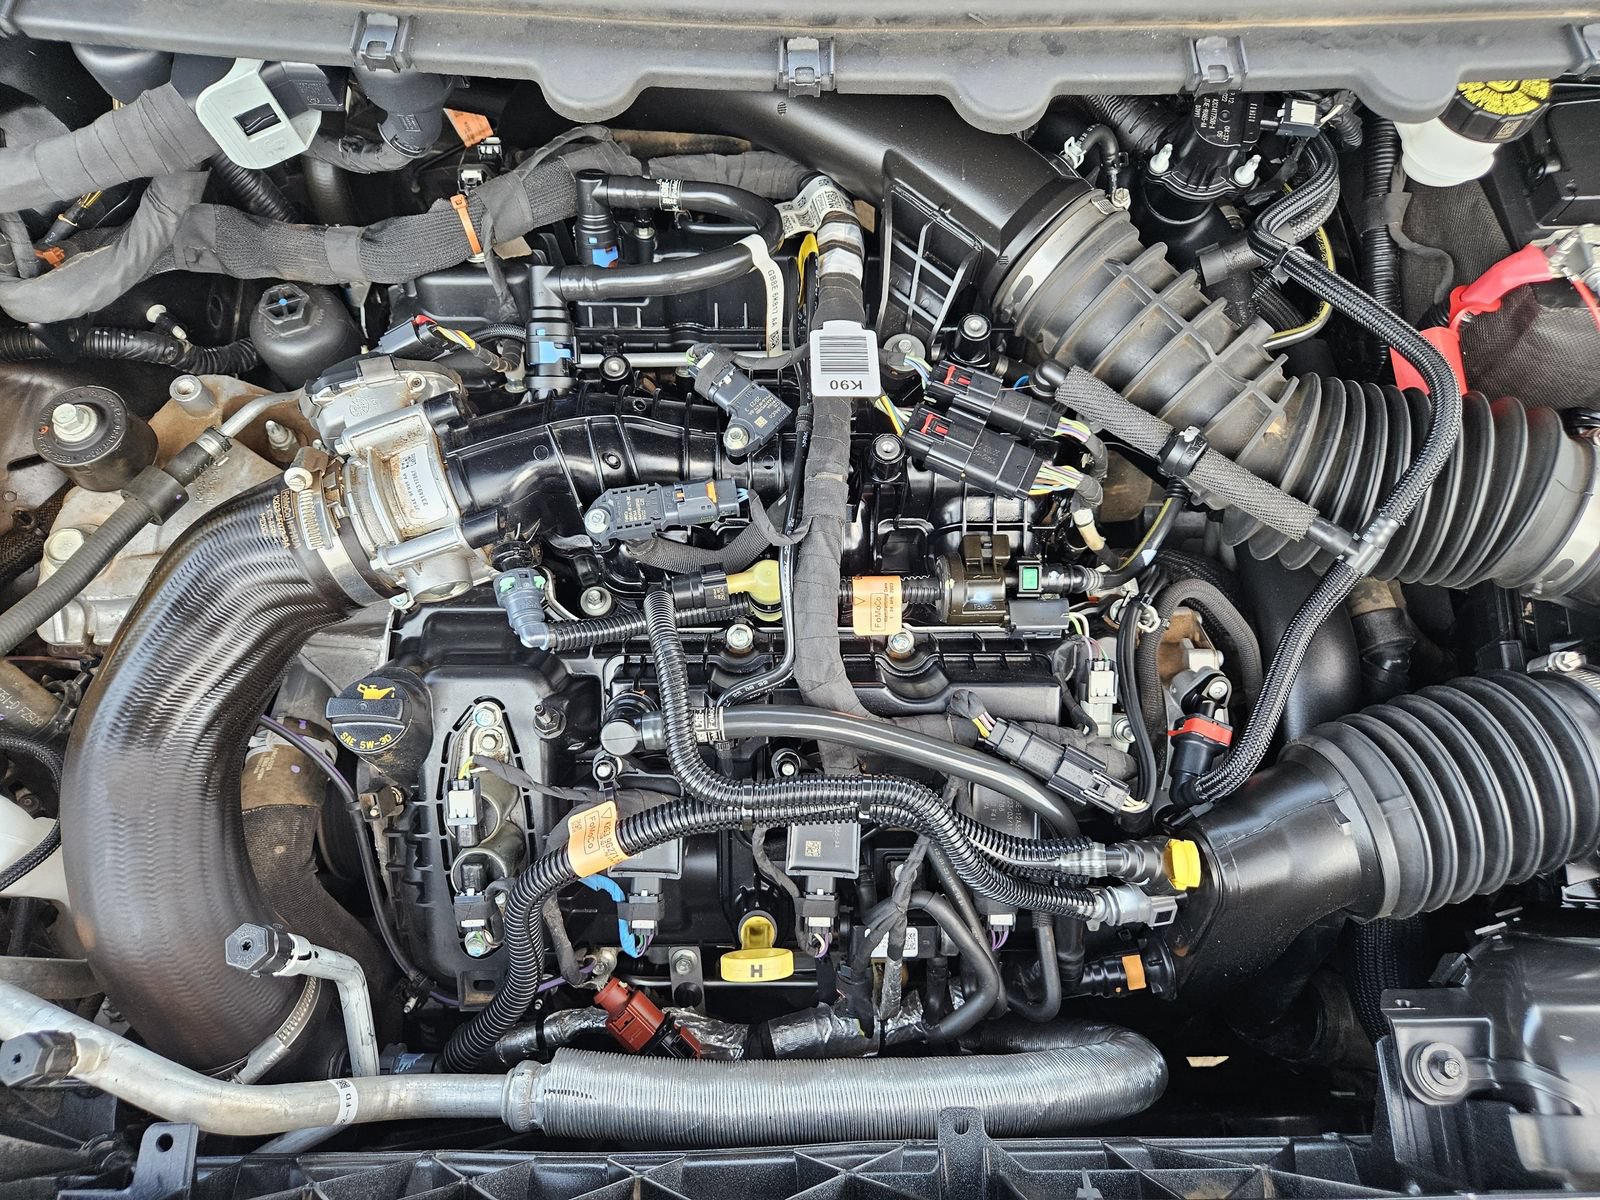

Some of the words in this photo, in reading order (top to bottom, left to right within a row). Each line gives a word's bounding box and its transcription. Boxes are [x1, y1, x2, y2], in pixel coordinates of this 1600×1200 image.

[830, 379, 863, 391] K90
[339, 731, 357, 748] SAE
[359, 733, 392, 750] 5W-30
[750, 964, 763, 978] H
